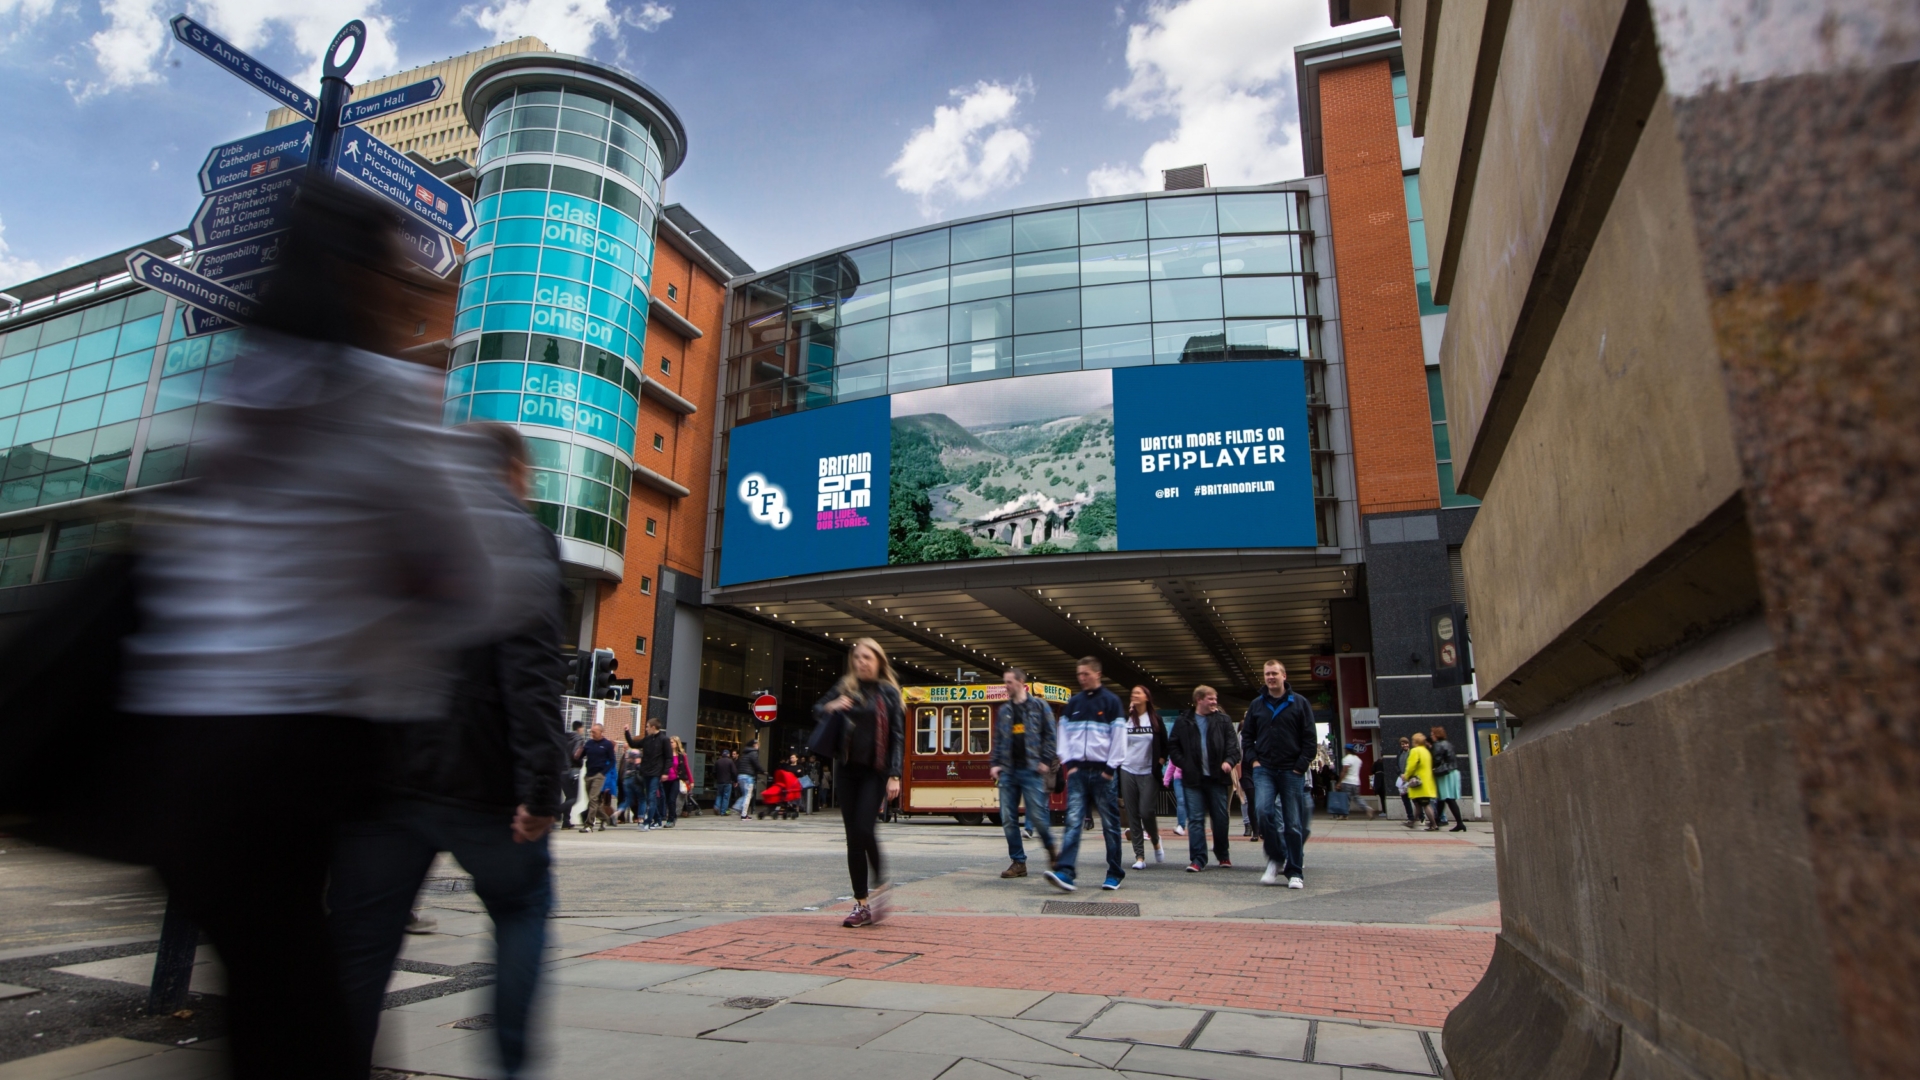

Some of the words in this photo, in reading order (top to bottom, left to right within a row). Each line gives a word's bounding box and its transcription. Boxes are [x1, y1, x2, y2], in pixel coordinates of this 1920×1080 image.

[330, 28, 349, 51] Market
[191, 28, 208, 47] St
[213, 42, 250, 72] Ann's
[254, 67, 299, 102] Square
[355, 101, 380, 116] Town
[383, 93, 405, 108] Hall
[219, 149, 260, 169] Cathedral
[263, 138, 299, 156] Gardens
[221, 145, 244, 158] Urbis
[366, 138, 417, 178] Metrolink
[216, 169, 248, 185] Victoria
[364, 152, 414, 191] Piccadilly
[217, 187, 258, 205] Exchange
[260, 178, 292, 195] Square
[361, 167, 411, 206] Piccadilly
[414, 201, 453, 231] Gardens
[215, 206, 230, 217] The
[232, 193, 279, 212] Printworks
[547, 202, 597, 227] clas
[210, 229, 231, 241] Corn
[233, 217, 275, 235] Exchange
[212, 214, 237, 229] IMAX
[238, 207, 270, 222] Cinema
[545, 223, 621, 260] ohlson
[204, 244, 260, 266] Shopmobility
[202, 265, 224, 278] Taxis
[151, 265, 251, 317] Spinningfield
[229, 279, 253, 292] dehill
[536, 285, 586, 311] clas
[200, 316, 223, 328] MEN
[533, 308, 612, 343] ohlson
[165, 334, 226, 373] clas
[525, 374, 576, 400] clas
[522, 395, 603, 430] ohlson
[1141, 434, 1182, 451] WATCH
[1186, 432, 1222, 447] MORE
[1225, 428, 1263, 445] FILMS
[1267, 427, 1285, 441] ON
[819, 452, 872, 477] BRITAIN
[818, 472, 871, 493] ON
[1155, 487, 1179, 498] @BFI
[1194, 480, 1275, 496] #BRITAINONFILM
[817, 489, 871, 511] FILM
[817, 510, 833, 521] OUR
[835, 508, 859, 519] LIVES.
[817, 520, 833, 530] OUR
[834, 517, 870, 529] STORIES.
[930, 688, 948, 696] BEEF
[950, 687, 985, 700] £2.50
[1044, 685, 1057, 694] BEEF
